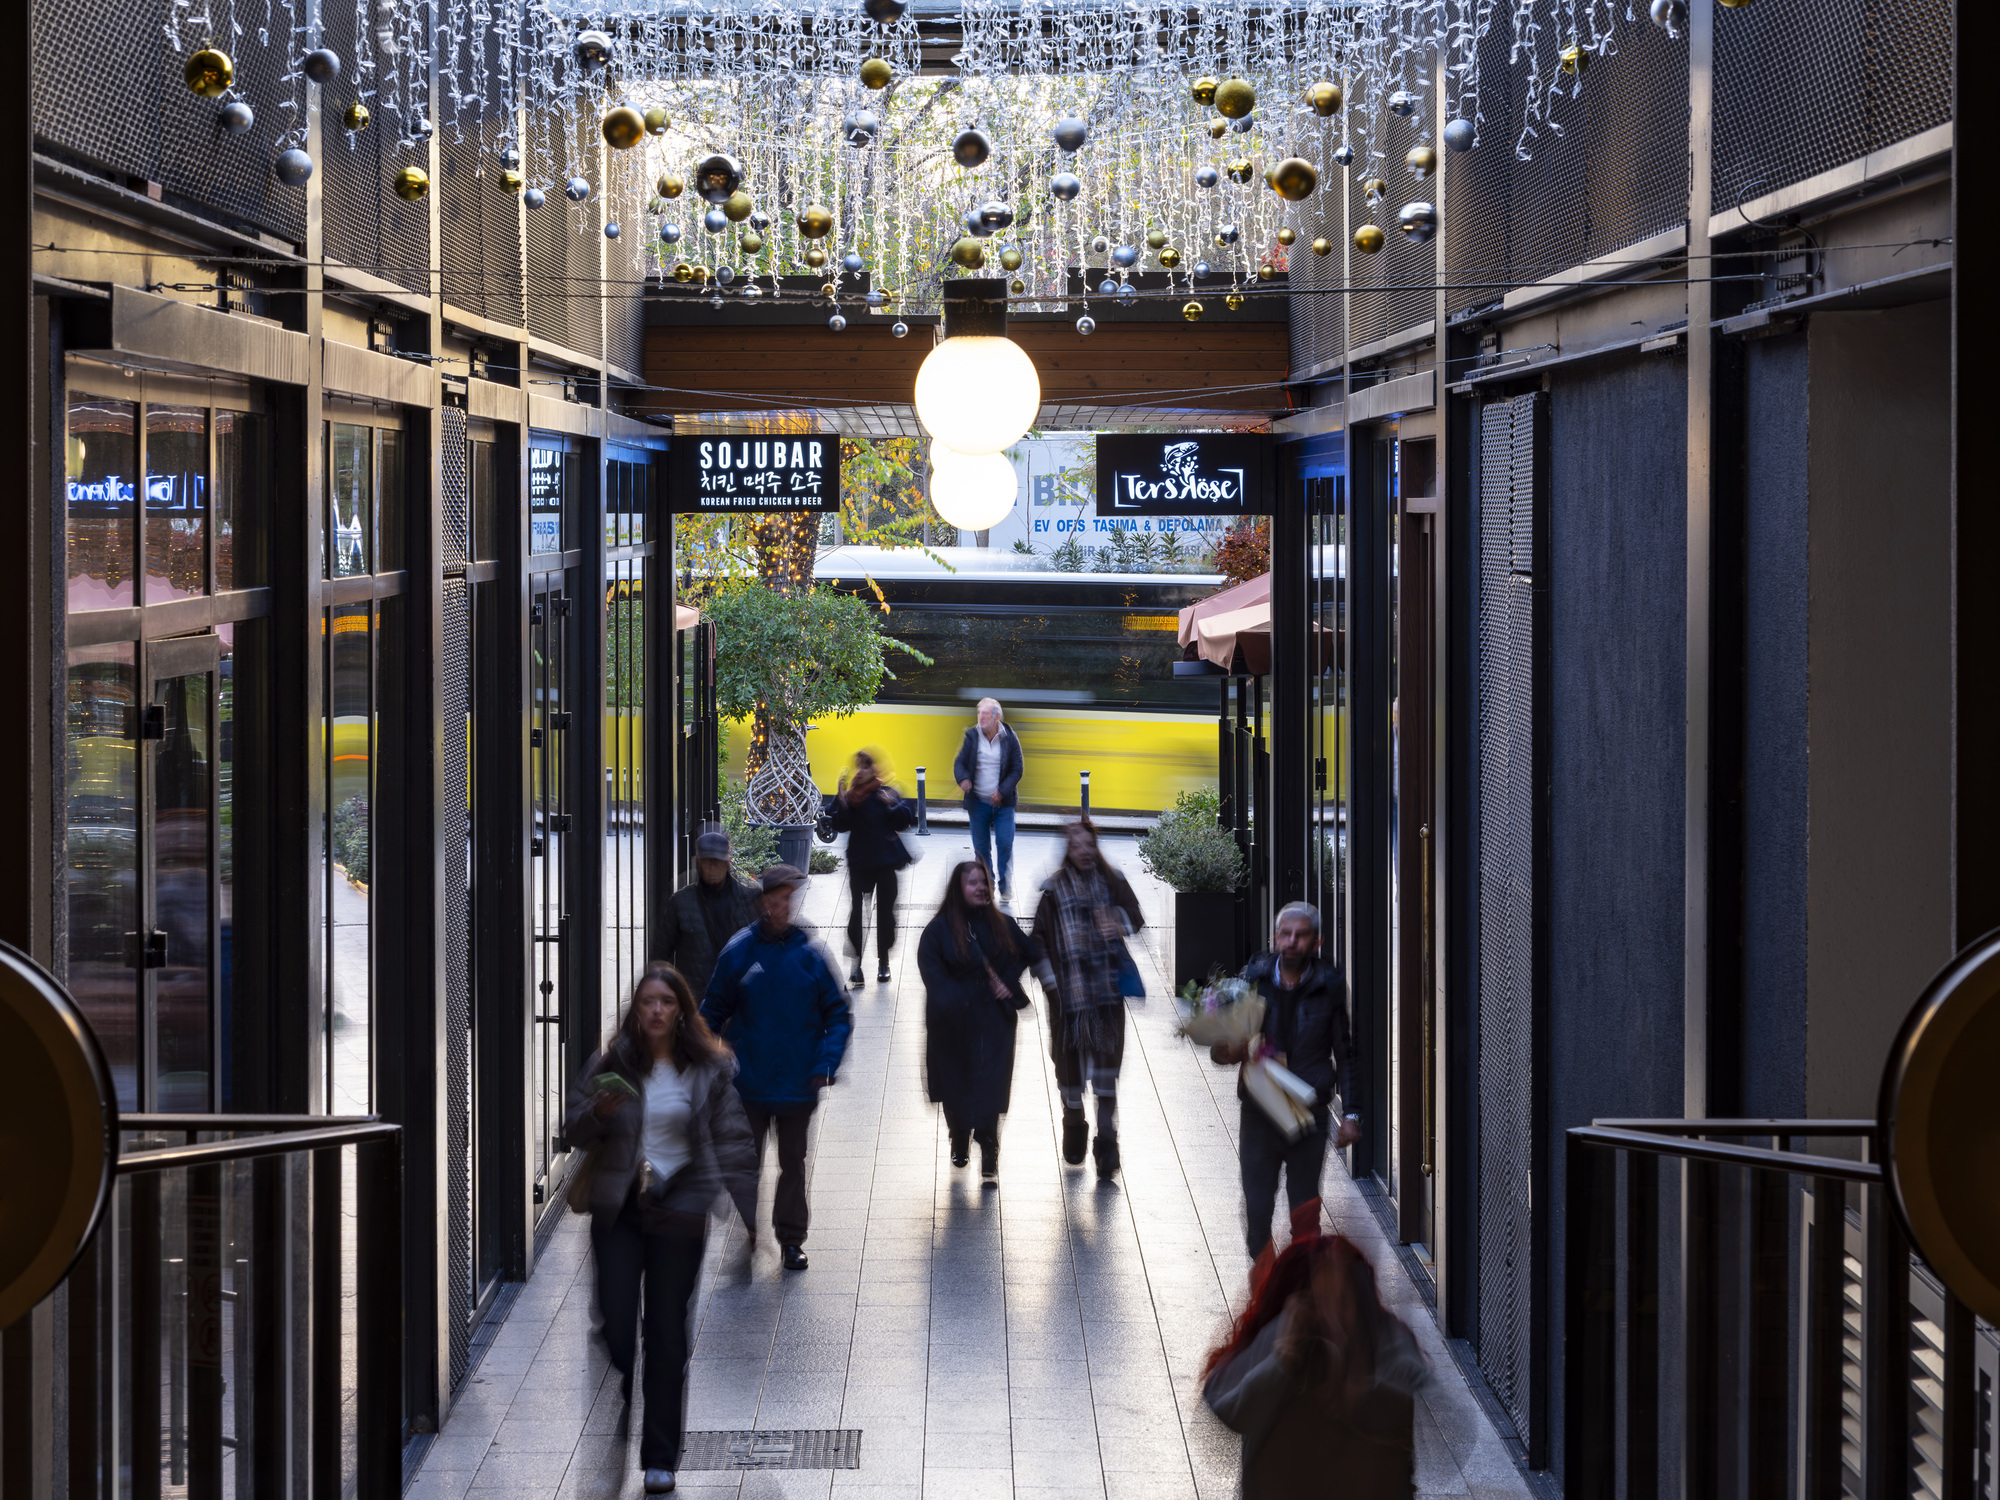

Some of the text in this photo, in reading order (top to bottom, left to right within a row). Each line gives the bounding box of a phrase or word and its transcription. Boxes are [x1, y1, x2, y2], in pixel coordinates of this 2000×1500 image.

[700, 442, 822, 469] SOJUBAR
[701, 470, 822, 494] 치킨 맥주 소주
[700, 497, 822, 506] KOREAN FRIED CHICKEN & BEER
[1034, 519, 1050, 532] EV
[1093, 519, 1138, 534] TAŞIMA
[1144, 519, 1152, 532] &
[1158, 518, 1223, 532] DEPOLAMA
